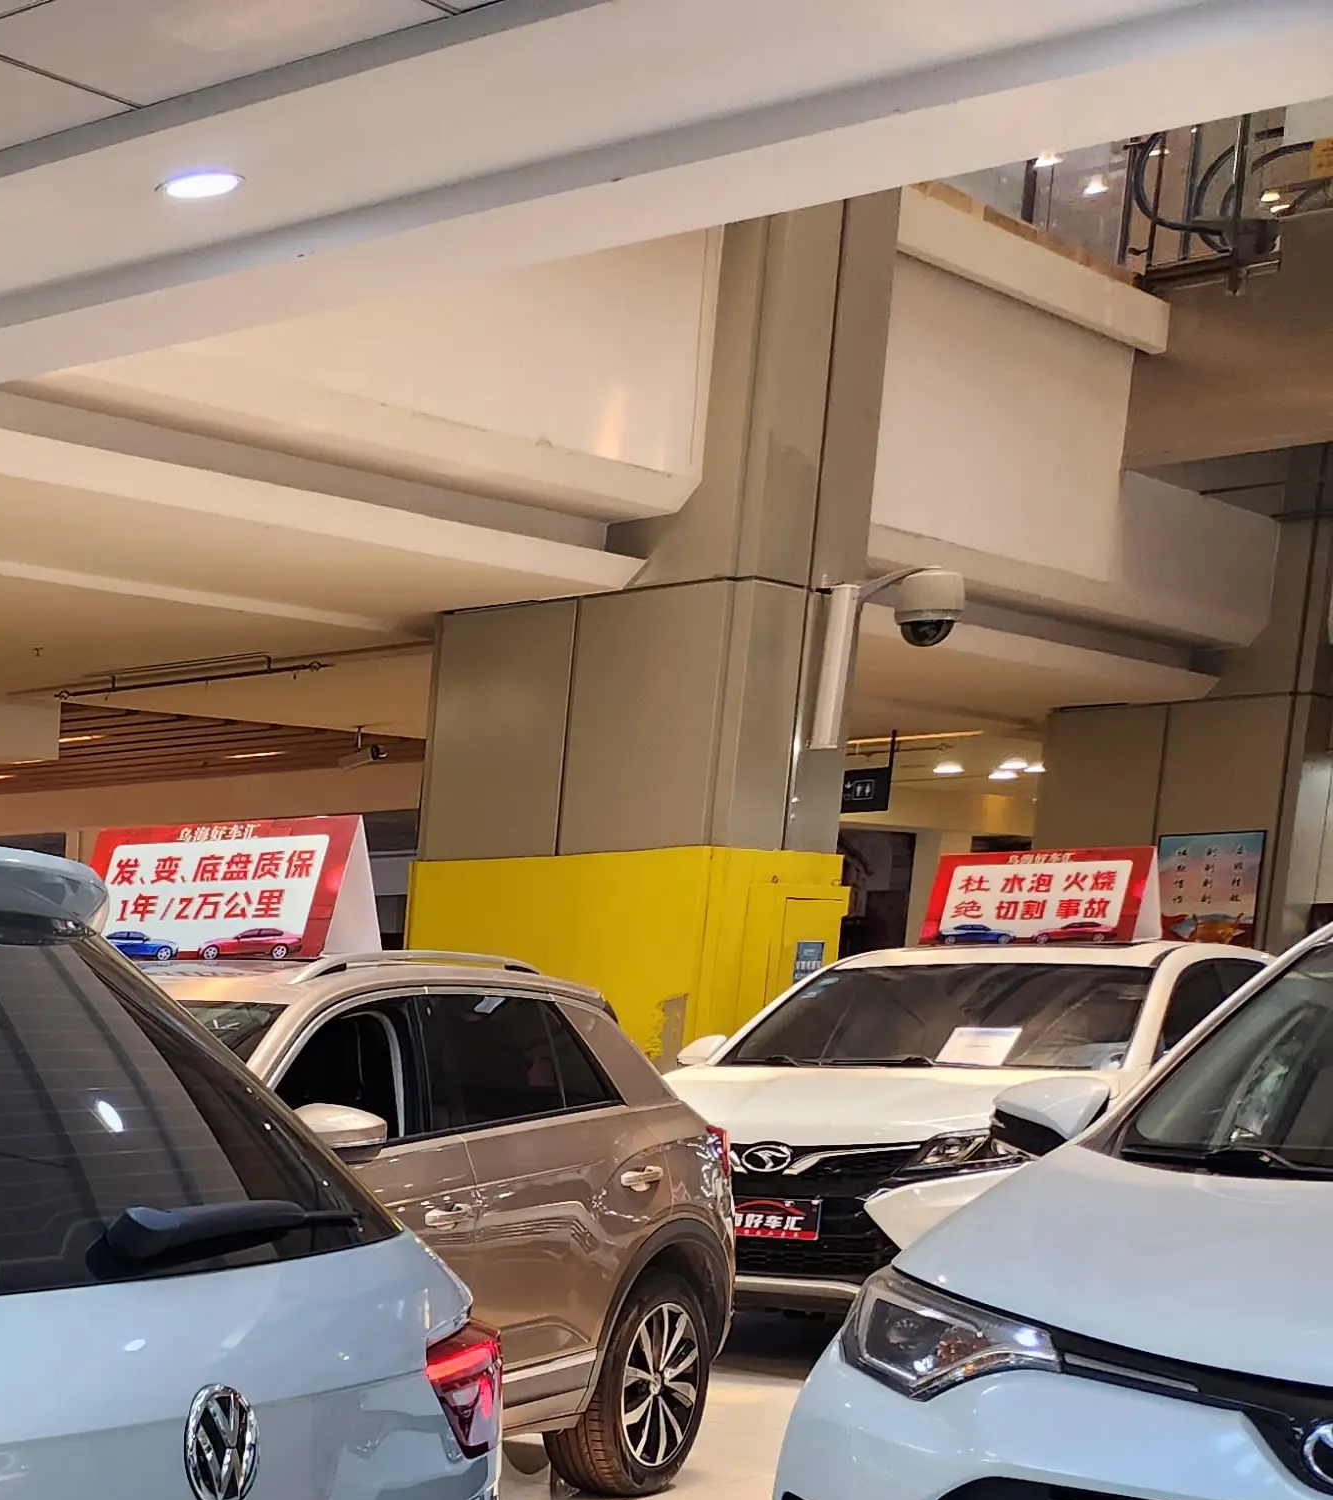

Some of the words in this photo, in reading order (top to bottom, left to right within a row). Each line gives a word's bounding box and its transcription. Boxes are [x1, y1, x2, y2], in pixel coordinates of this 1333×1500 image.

[176, 823, 261, 844] 乌海好车汇
[110, 849, 318, 886] 发、变、底盘质保
[957, 875, 991, 895] 杜
[1000, 873, 1054, 894] 水泡
[1061, 870, 1118, 892] 火烧
[116, 888, 285, 923] 1年/2万公里
[950, 900, 984, 920] 绝
[994, 899, 1048, 920] 切割
[1055, 898, 1111, 920] 事故
